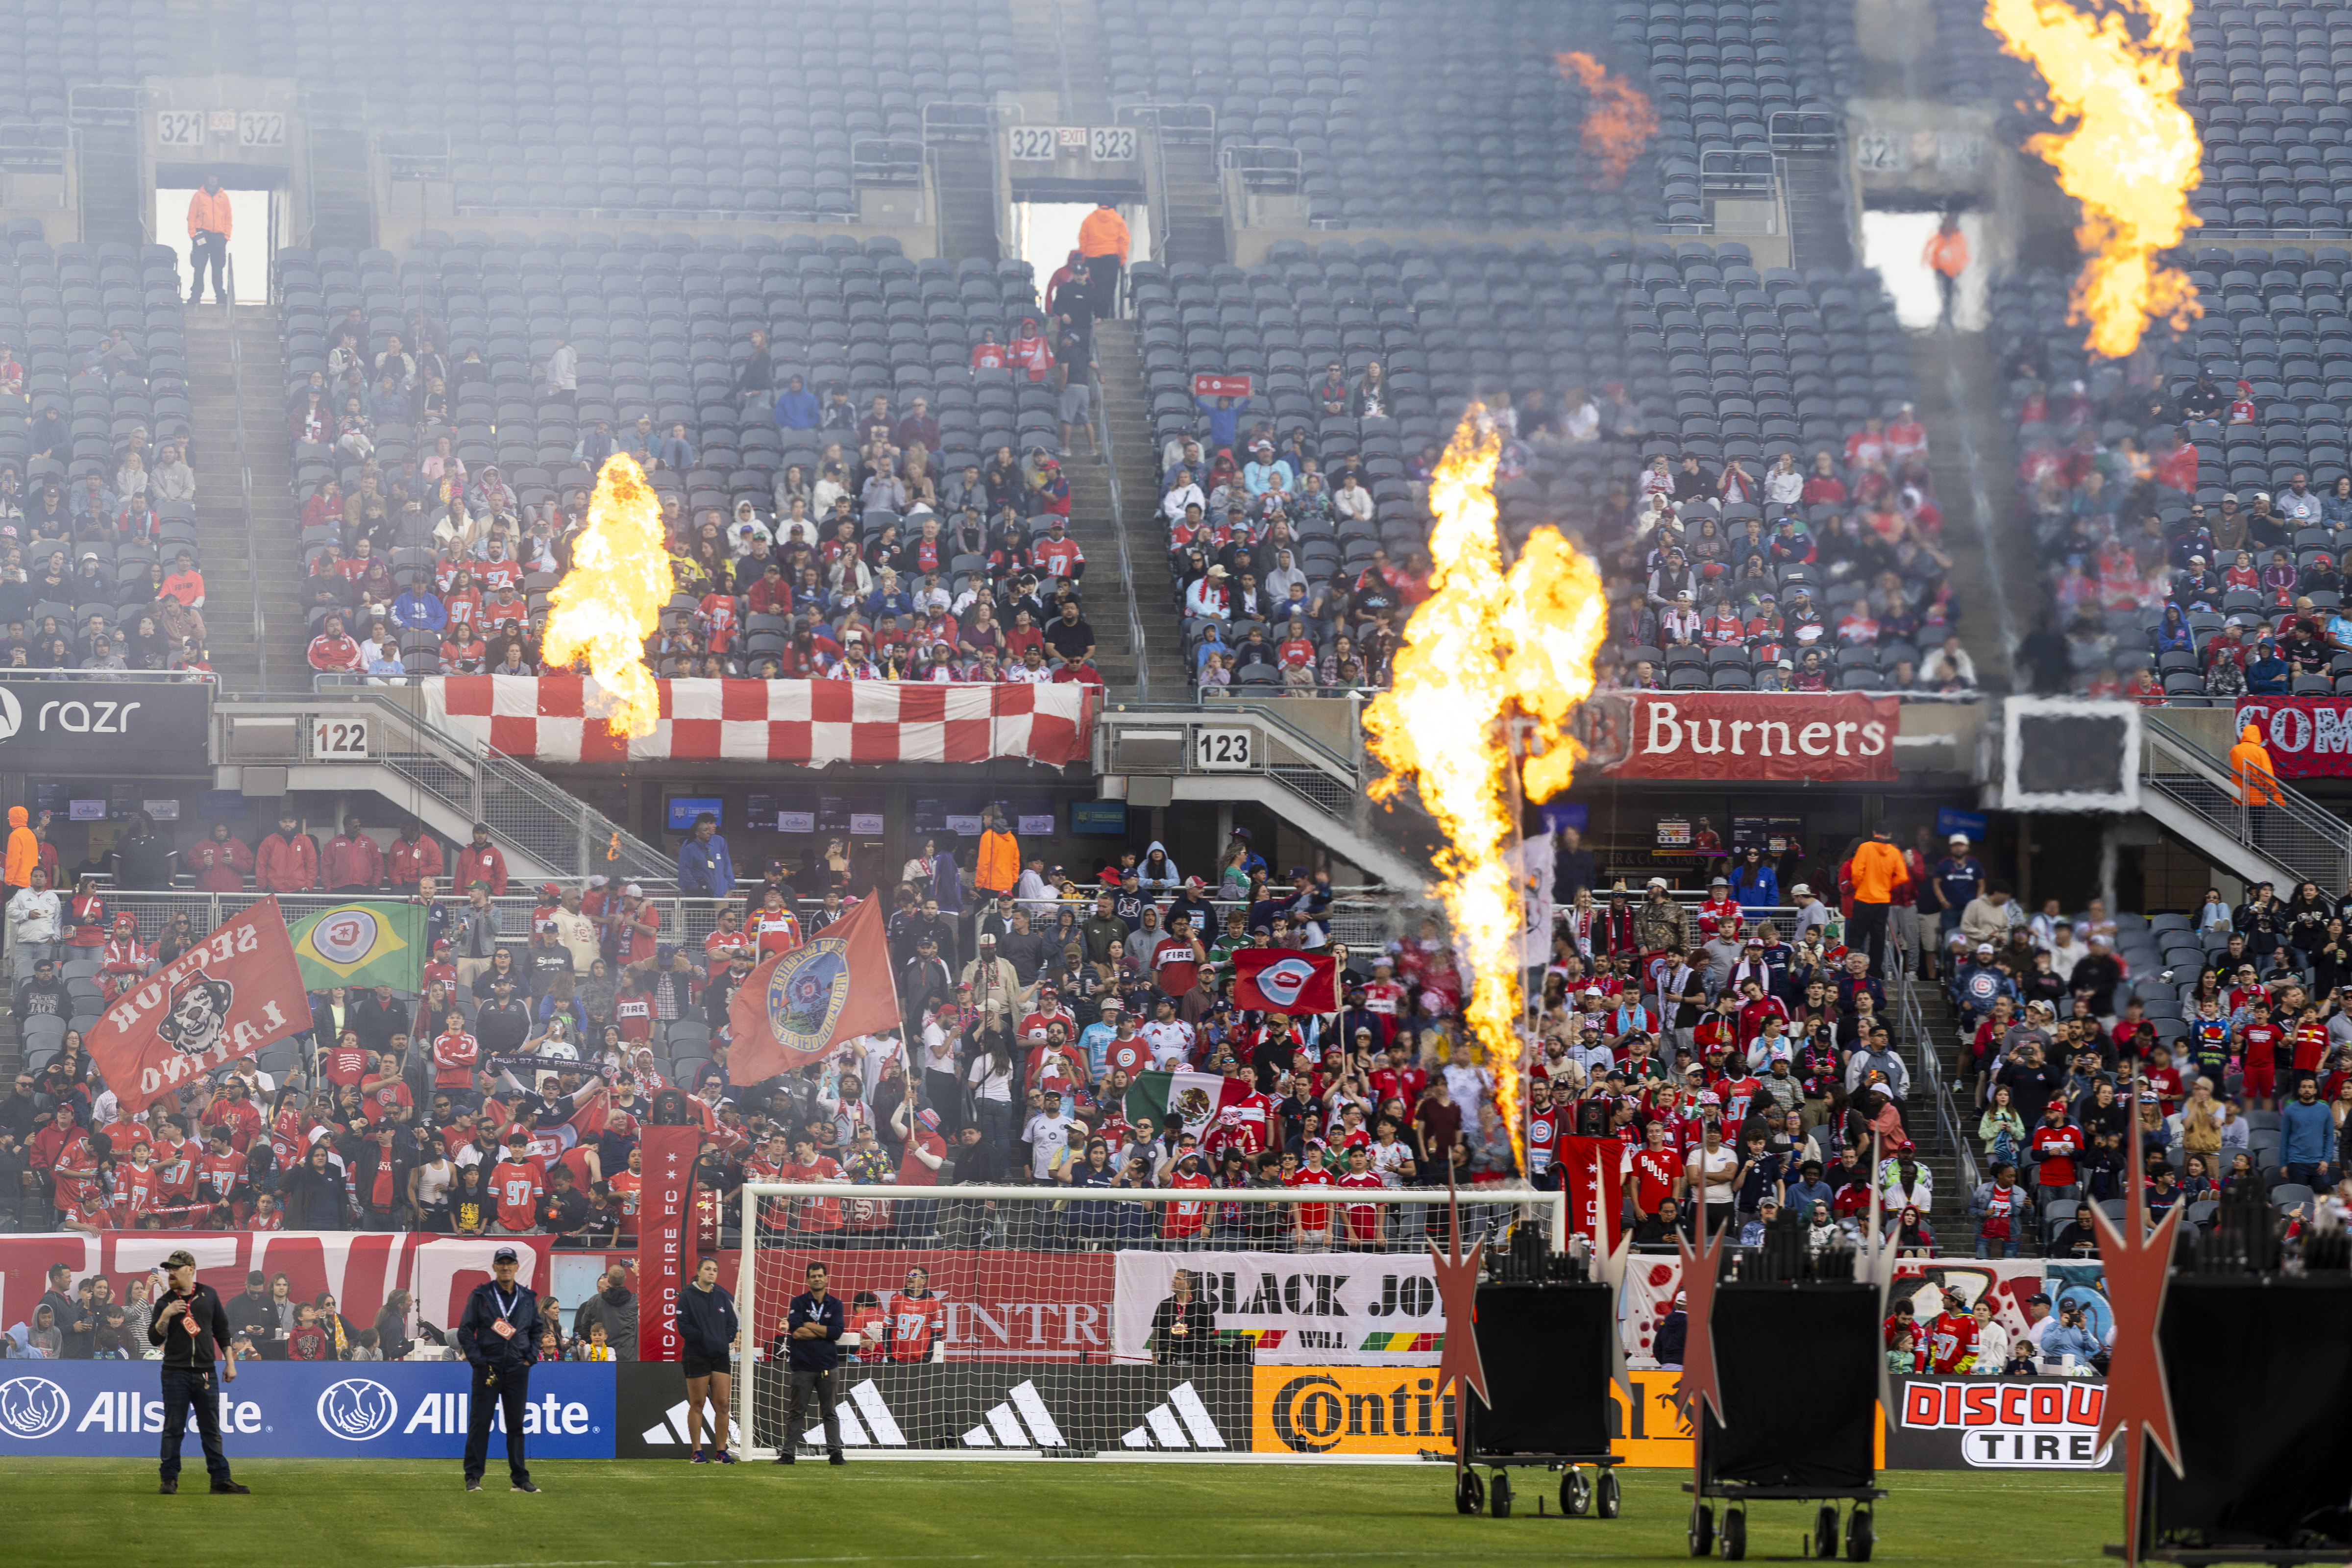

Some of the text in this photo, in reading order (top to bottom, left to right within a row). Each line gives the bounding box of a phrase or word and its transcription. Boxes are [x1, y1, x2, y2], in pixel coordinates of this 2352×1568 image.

[161, 114, 201, 143] 321
[244, 115, 282, 144] 322
[1061, 129, 1085, 144] EXIT
[1013, 130, 1052, 158] 322
[1094, 130, 1133, 158] 323
[452, 602, 472, 622] 97
[40, 701, 141, 732] razr
[1642, 701, 1886, 757] Burners
[317, 724, 365, 751] 122
[1200, 735, 1248, 762] 123
[1638, 855, 1705, 865] COCKTAILS
[1166, 951, 1191, 959] FIRE
[620, 1005, 645, 1013] FIRE
[1727, 1096, 1751, 1121] 97
[164, 1160, 191, 1184] 97
[1641, 1155, 1669, 1186] BULLS
[212, 1171, 235, 1197] 97
[506, 1180, 531, 1205] 97
[131, 1185, 148, 1211] 97
[663, 1190, 678, 1361] ICAGO FIRE FC
[1193, 1272, 1446, 1318] BLACK JO
[897, 1313, 925, 1341] 97
[1298, 1331, 1348, 1349] WILL
[1936, 1335, 1959, 1361] 97
[1903, 1382, 2106, 1428] DISCOU
[1980, 1434, 2091, 1460] TIRE
